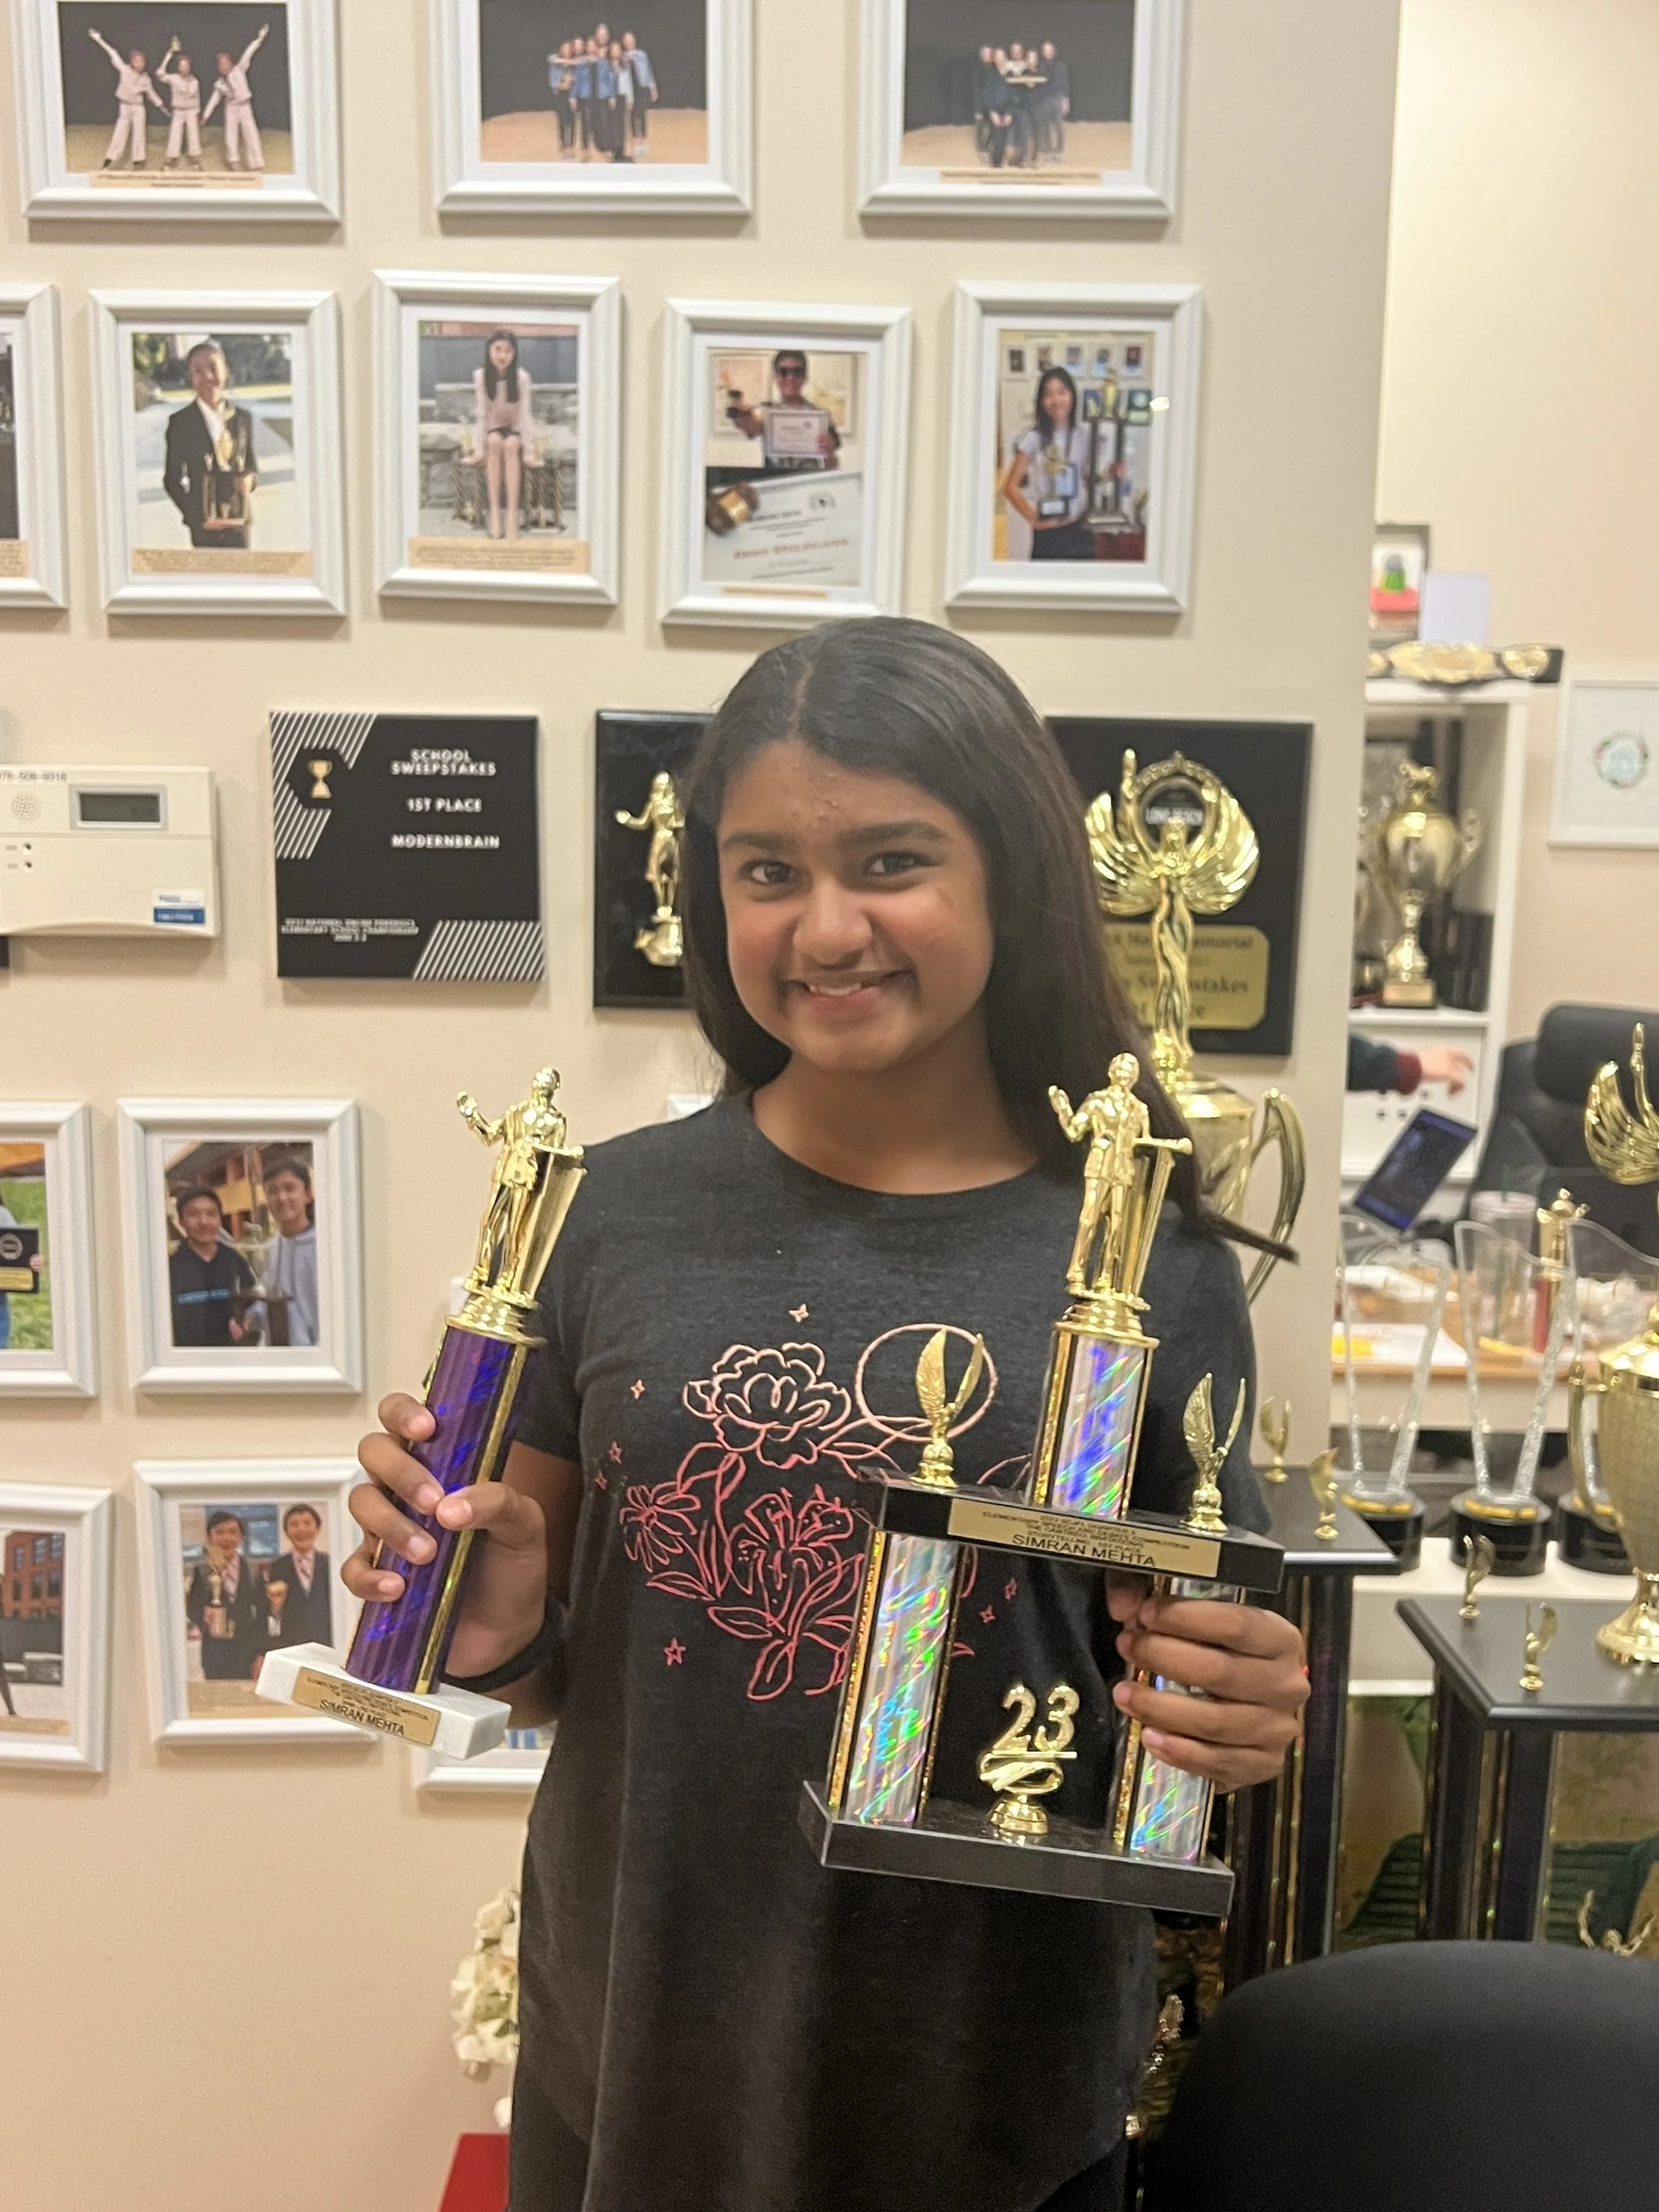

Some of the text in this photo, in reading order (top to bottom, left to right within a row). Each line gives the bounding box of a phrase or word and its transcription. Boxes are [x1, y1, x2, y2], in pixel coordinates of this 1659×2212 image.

[410, 749, 472, 763] SCHOOL
[390, 761, 496, 776] SWEEPSTAKES
[407, 797, 482, 813] 1ST PLACE
[391, 834, 500, 849] MODERNBRAIN
[1012, 1534, 1156, 1567] SIMRAN MEHTA
[319, 1699, 405, 1736] SIMRAN MEHTA
[993, 1684, 1080, 1752] 23
